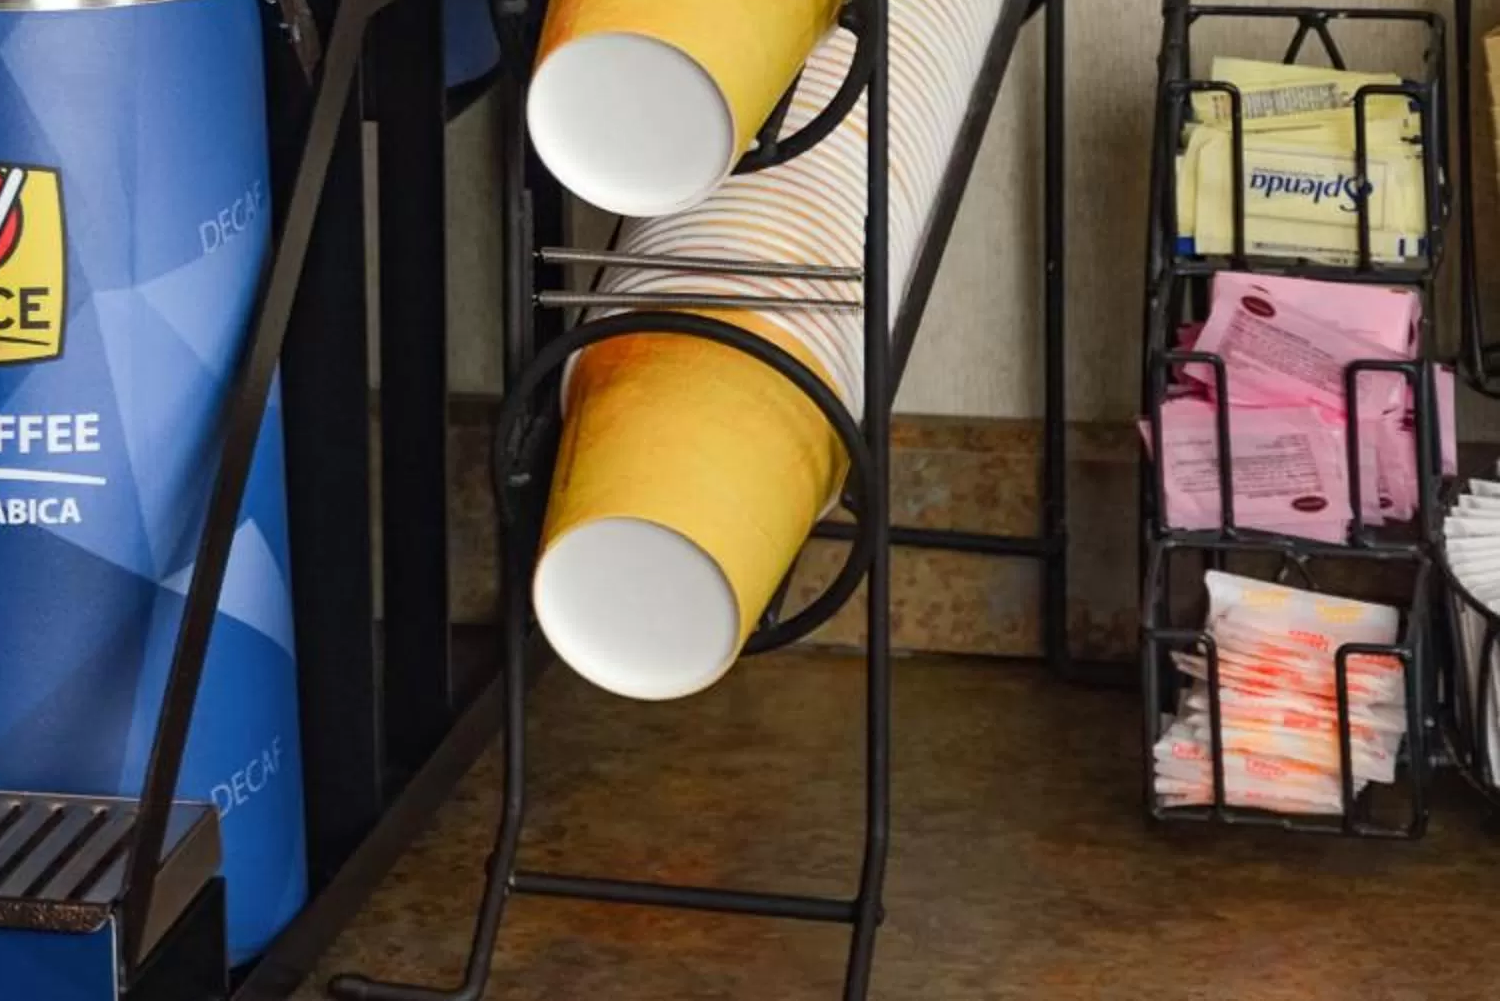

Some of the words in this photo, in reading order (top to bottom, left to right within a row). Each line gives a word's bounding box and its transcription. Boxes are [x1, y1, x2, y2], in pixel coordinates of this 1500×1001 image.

[199, 179, 261, 255] DECAF
[1250, 173, 1373, 213] Splenda
[211, 734, 283, 821] DECAF
